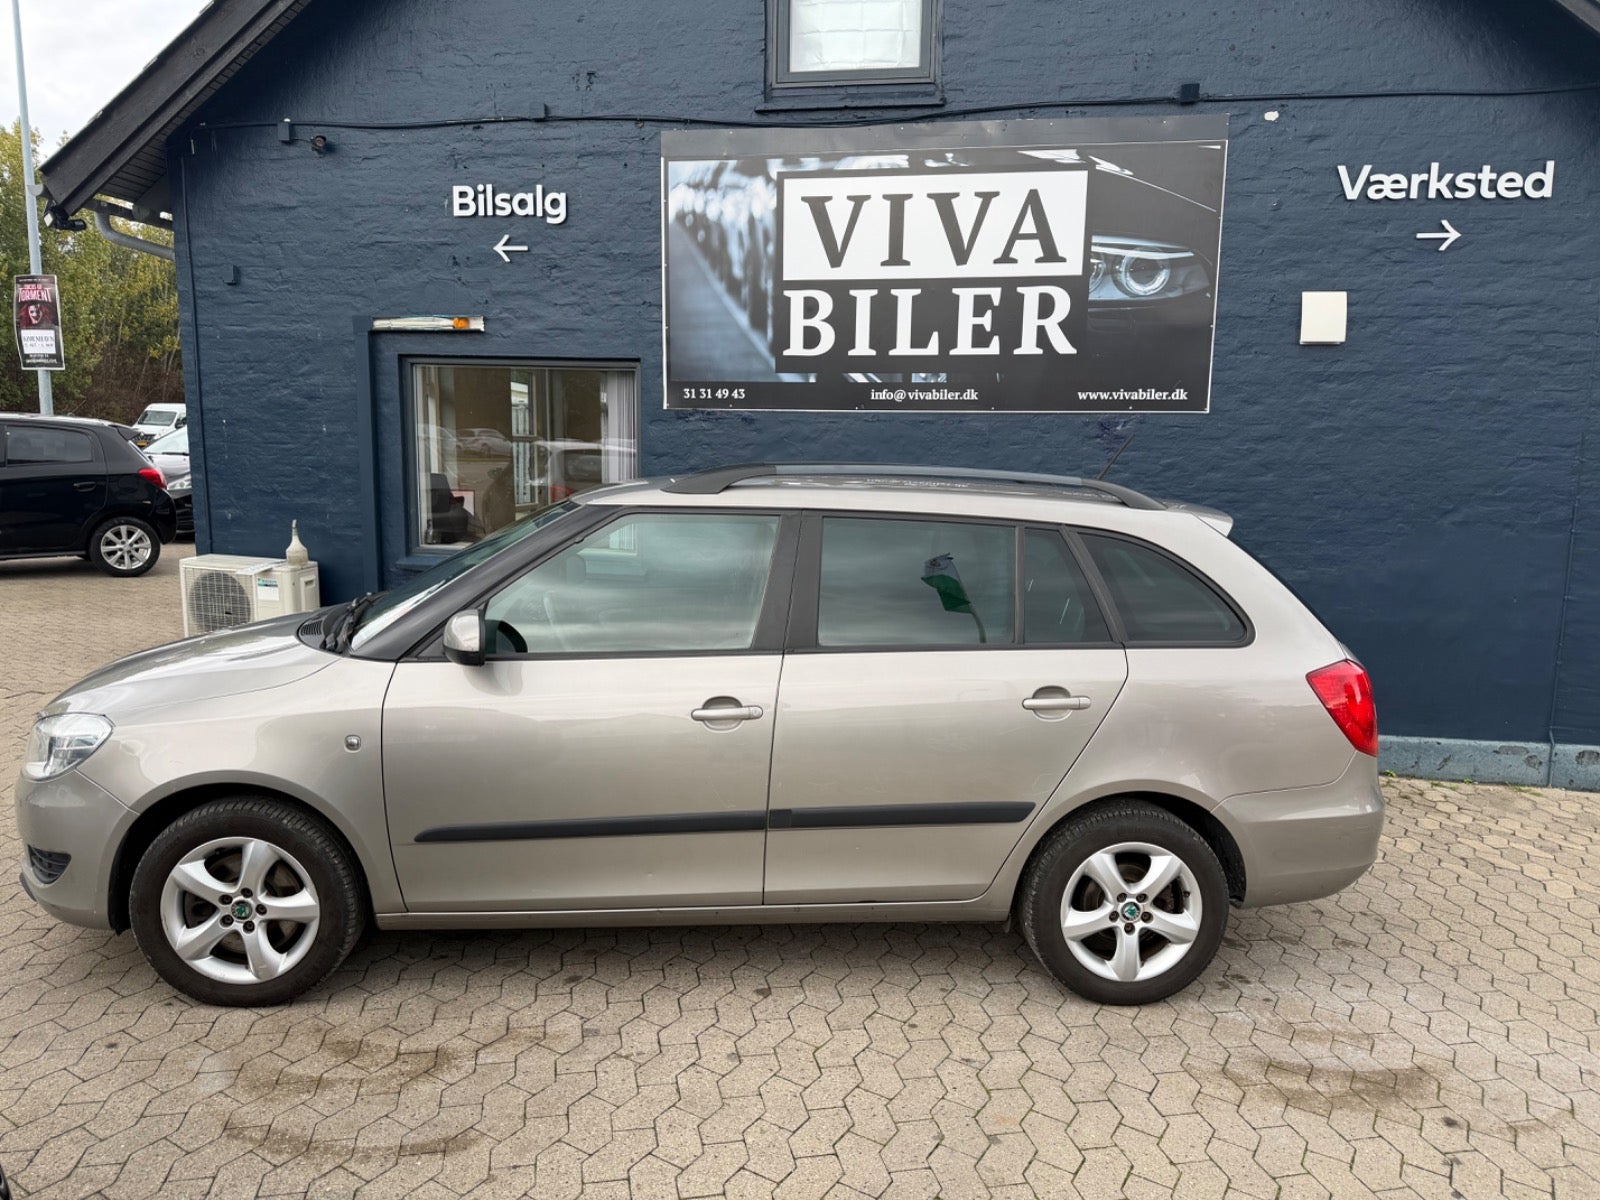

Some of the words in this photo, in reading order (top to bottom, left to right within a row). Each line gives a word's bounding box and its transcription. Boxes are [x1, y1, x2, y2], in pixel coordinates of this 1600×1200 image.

[1337, 160, 1555, 201] Værksted
[452, 183, 567, 224] Bilsalg
[801, 188, 1067, 268] VIVA
[782, 285, 1077, 357] BILER
[683, 388, 696, 399] 31
[699, 388, 712, 399] 31
[715, 388, 729, 399] 49
[731, 388, 746, 399] 43
[1077, 388, 1188, 400] www.vivabiler.dk
